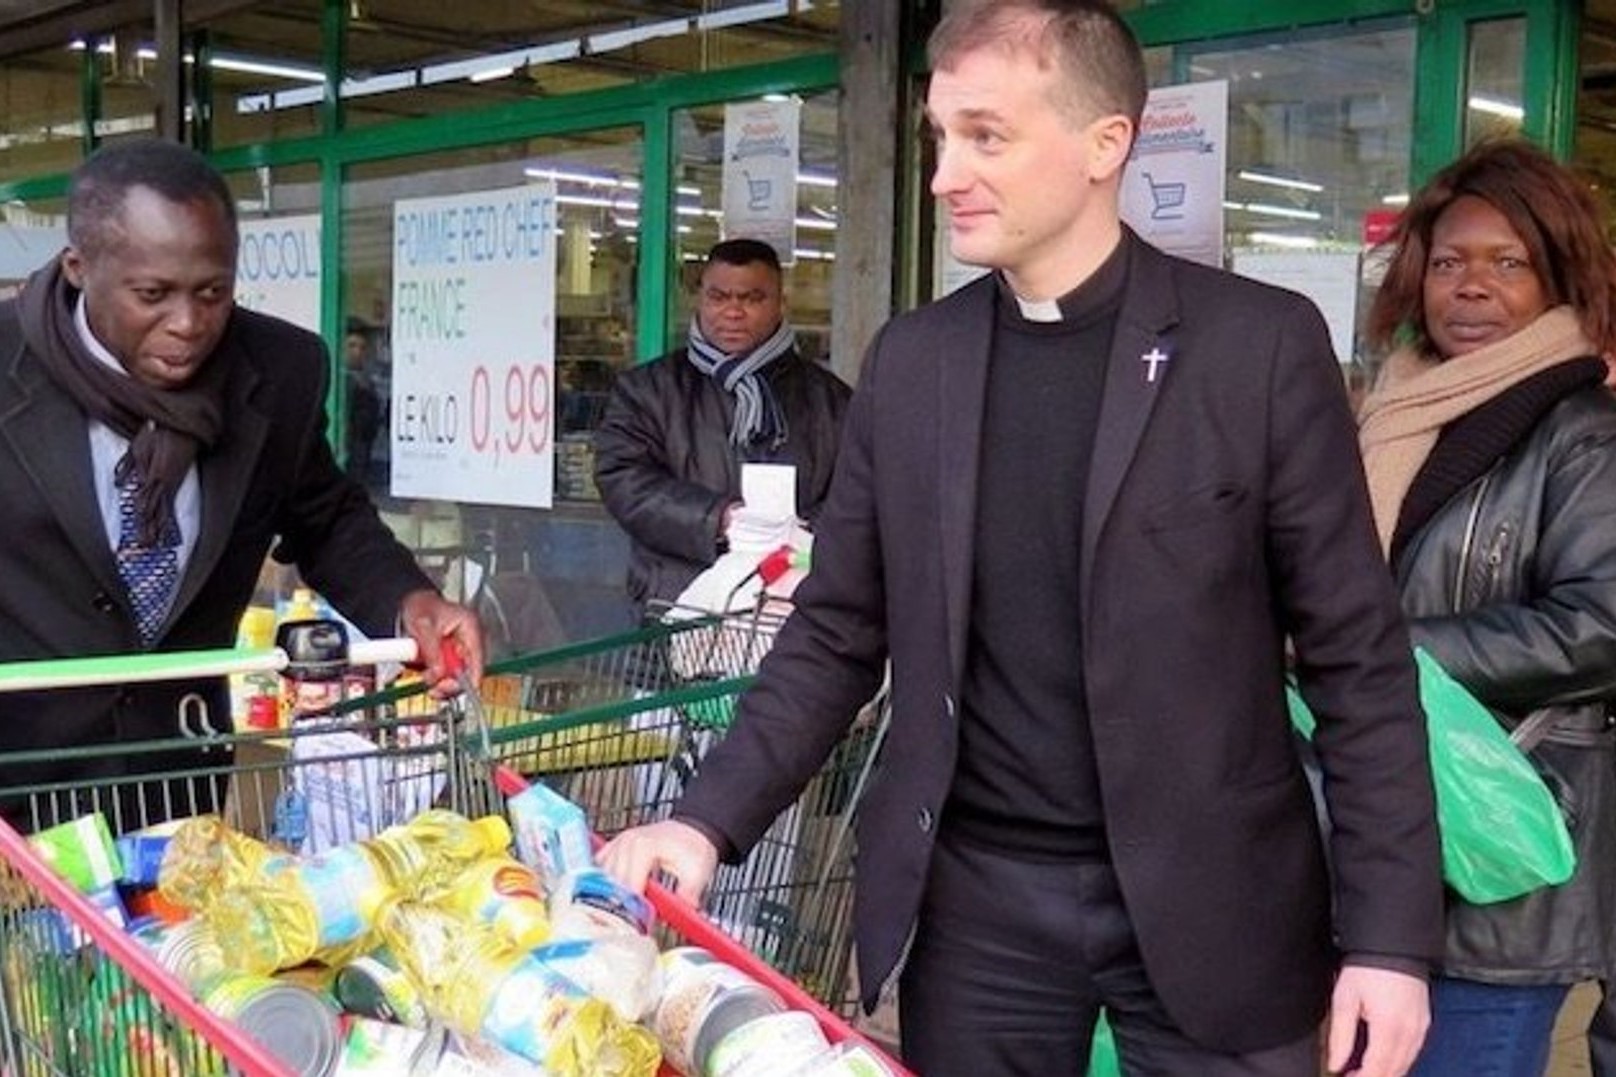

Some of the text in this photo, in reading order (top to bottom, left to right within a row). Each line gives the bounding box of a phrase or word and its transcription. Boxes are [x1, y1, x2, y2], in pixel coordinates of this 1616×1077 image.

[398, 196, 553, 266] POMME RED CHEF
[398, 277, 466, 341] FRANCE
[397, 394, 458, 443] LE KILO
[470, 363, 550, 470] 0,99
